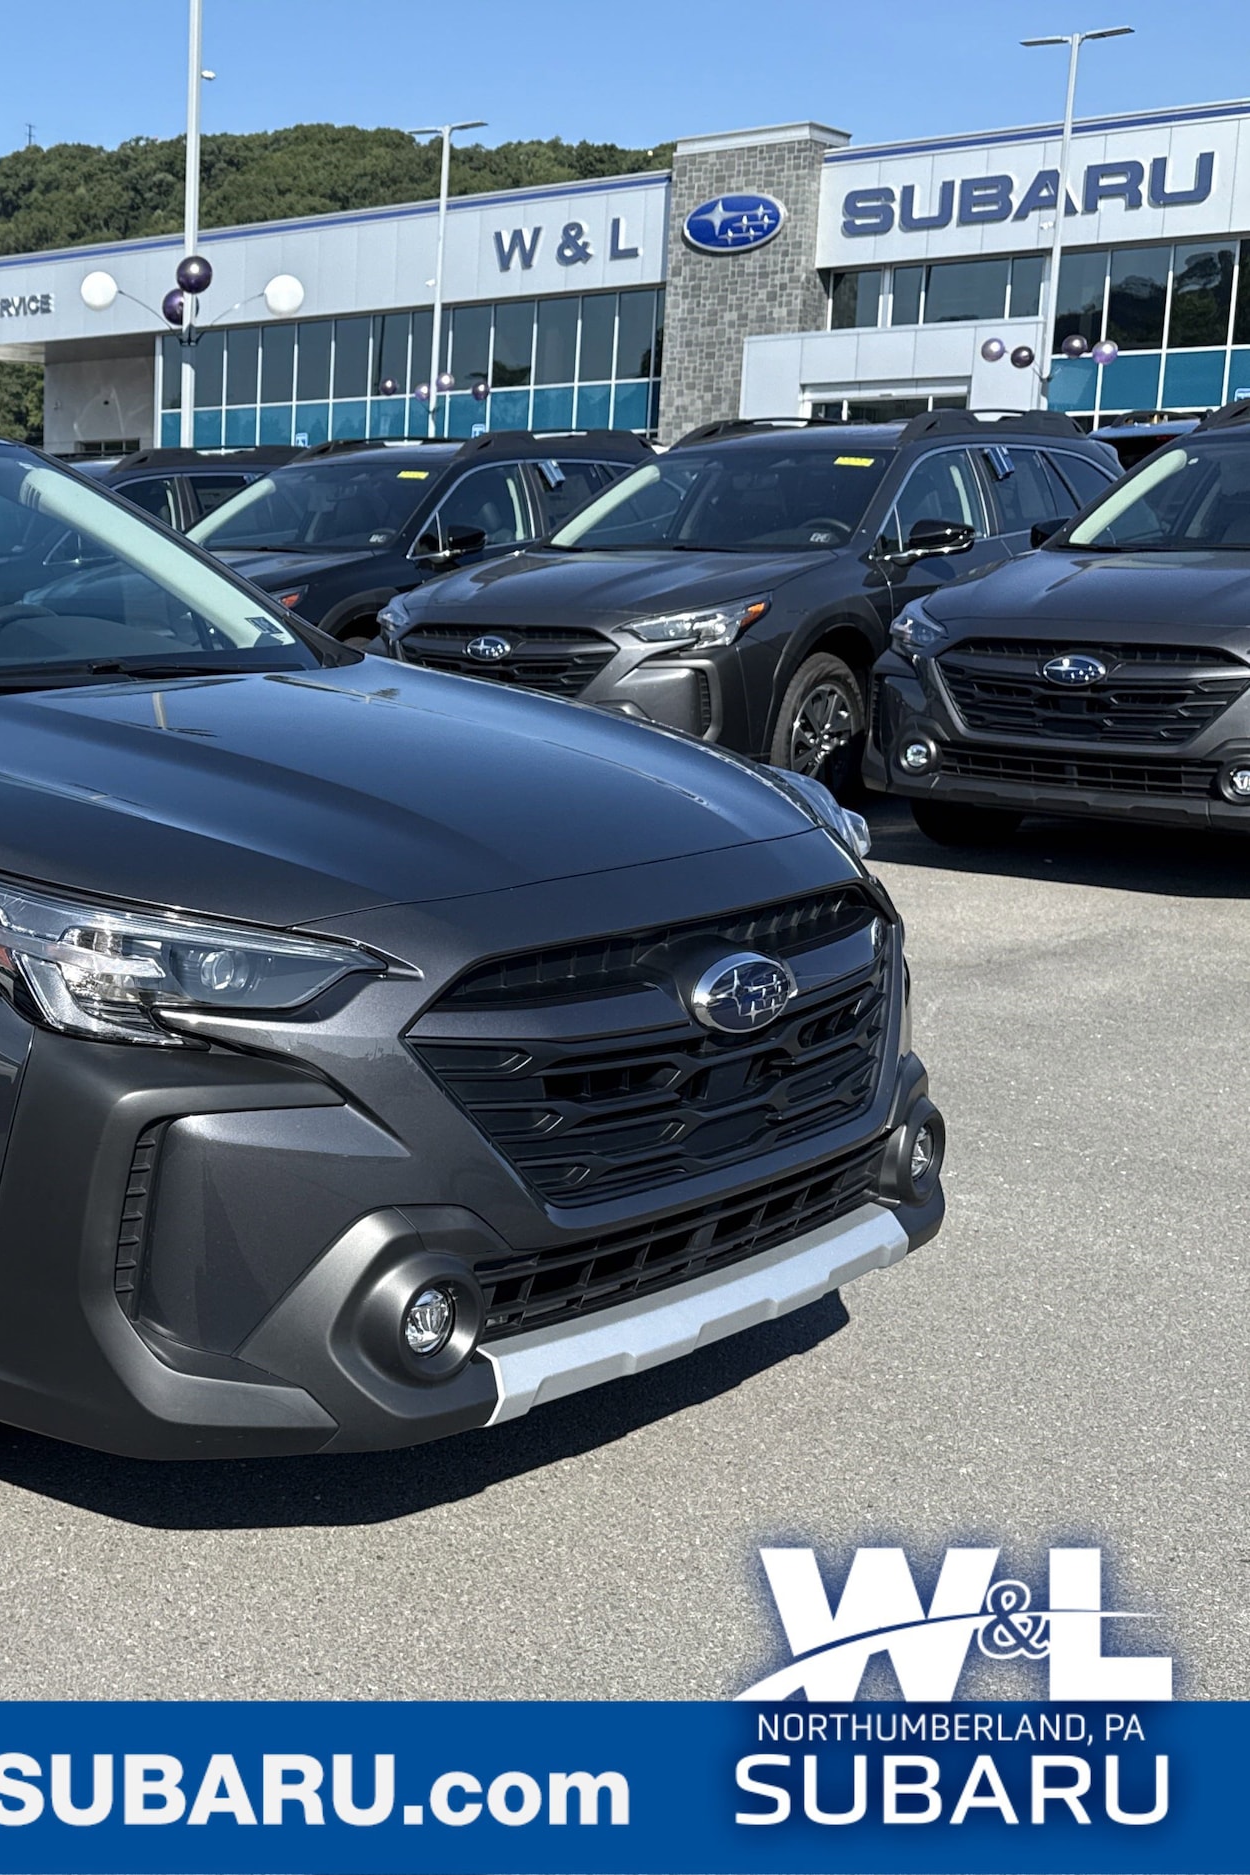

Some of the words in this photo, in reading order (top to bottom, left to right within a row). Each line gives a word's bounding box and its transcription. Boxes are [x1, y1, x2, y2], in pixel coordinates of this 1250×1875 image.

[841, 150, 1215, 238] SUBARU
[494, 226, 543, 273] W
[557, 221, 593, 267] &
[610, 217, 641, 261] L
